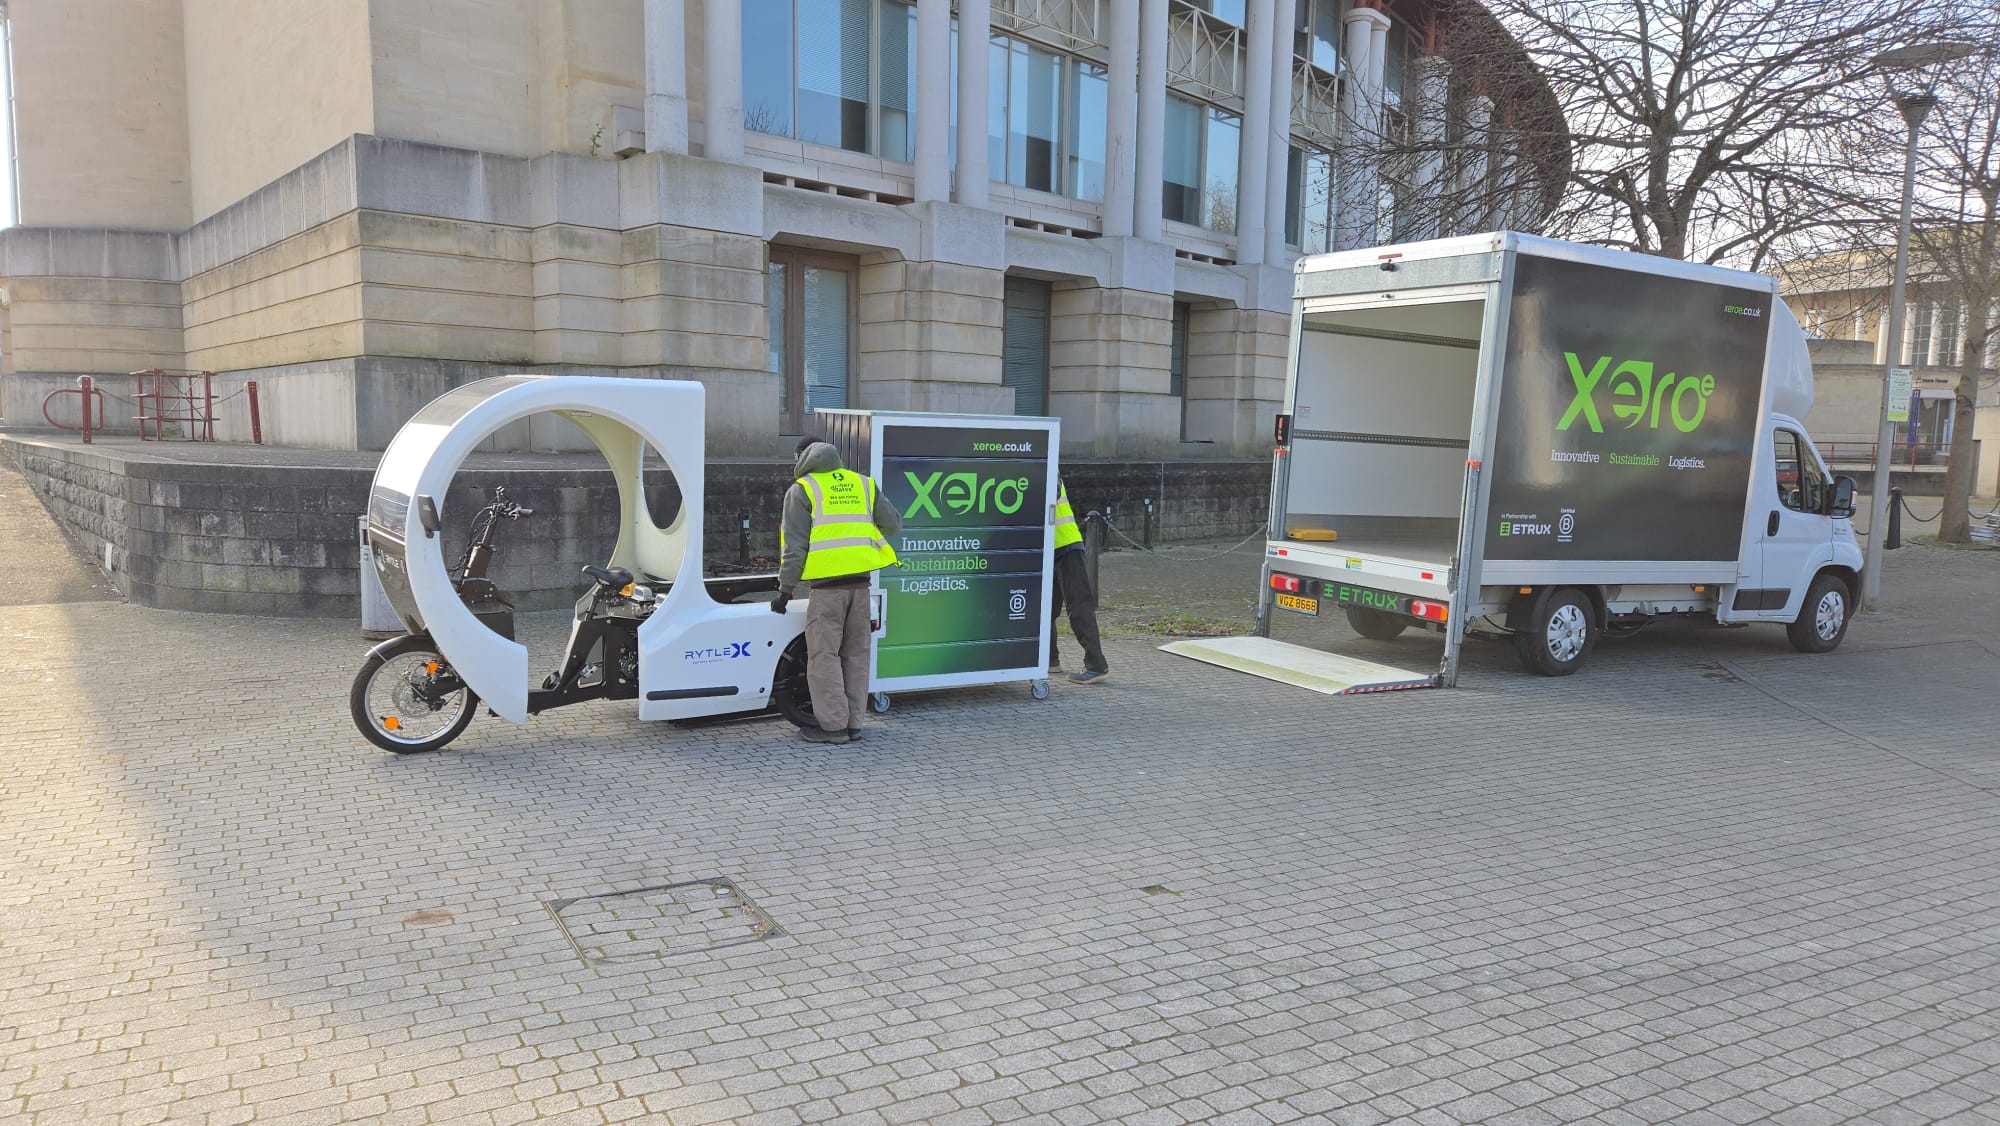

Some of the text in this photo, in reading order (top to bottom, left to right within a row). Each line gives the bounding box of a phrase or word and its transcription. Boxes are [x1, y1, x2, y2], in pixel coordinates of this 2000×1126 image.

[1724, 305, 1760, 317] xeroe.co.uk
[973, 442, 1032, 452] xeroe.co.uk
[1551, 450, 1705, 470] Innovative Sustainable Logistics.
[1512, 523, 1551, 535] ETRUX
[901, 536, 980, 551] Innovative
[902, 556, 988, 572] Sustainable
[900, 577, 969, 595] Logistics.
[1280, 594, 1316, 611] VGZ 8668
[1339, 586, 1399, 610] ETRUX
